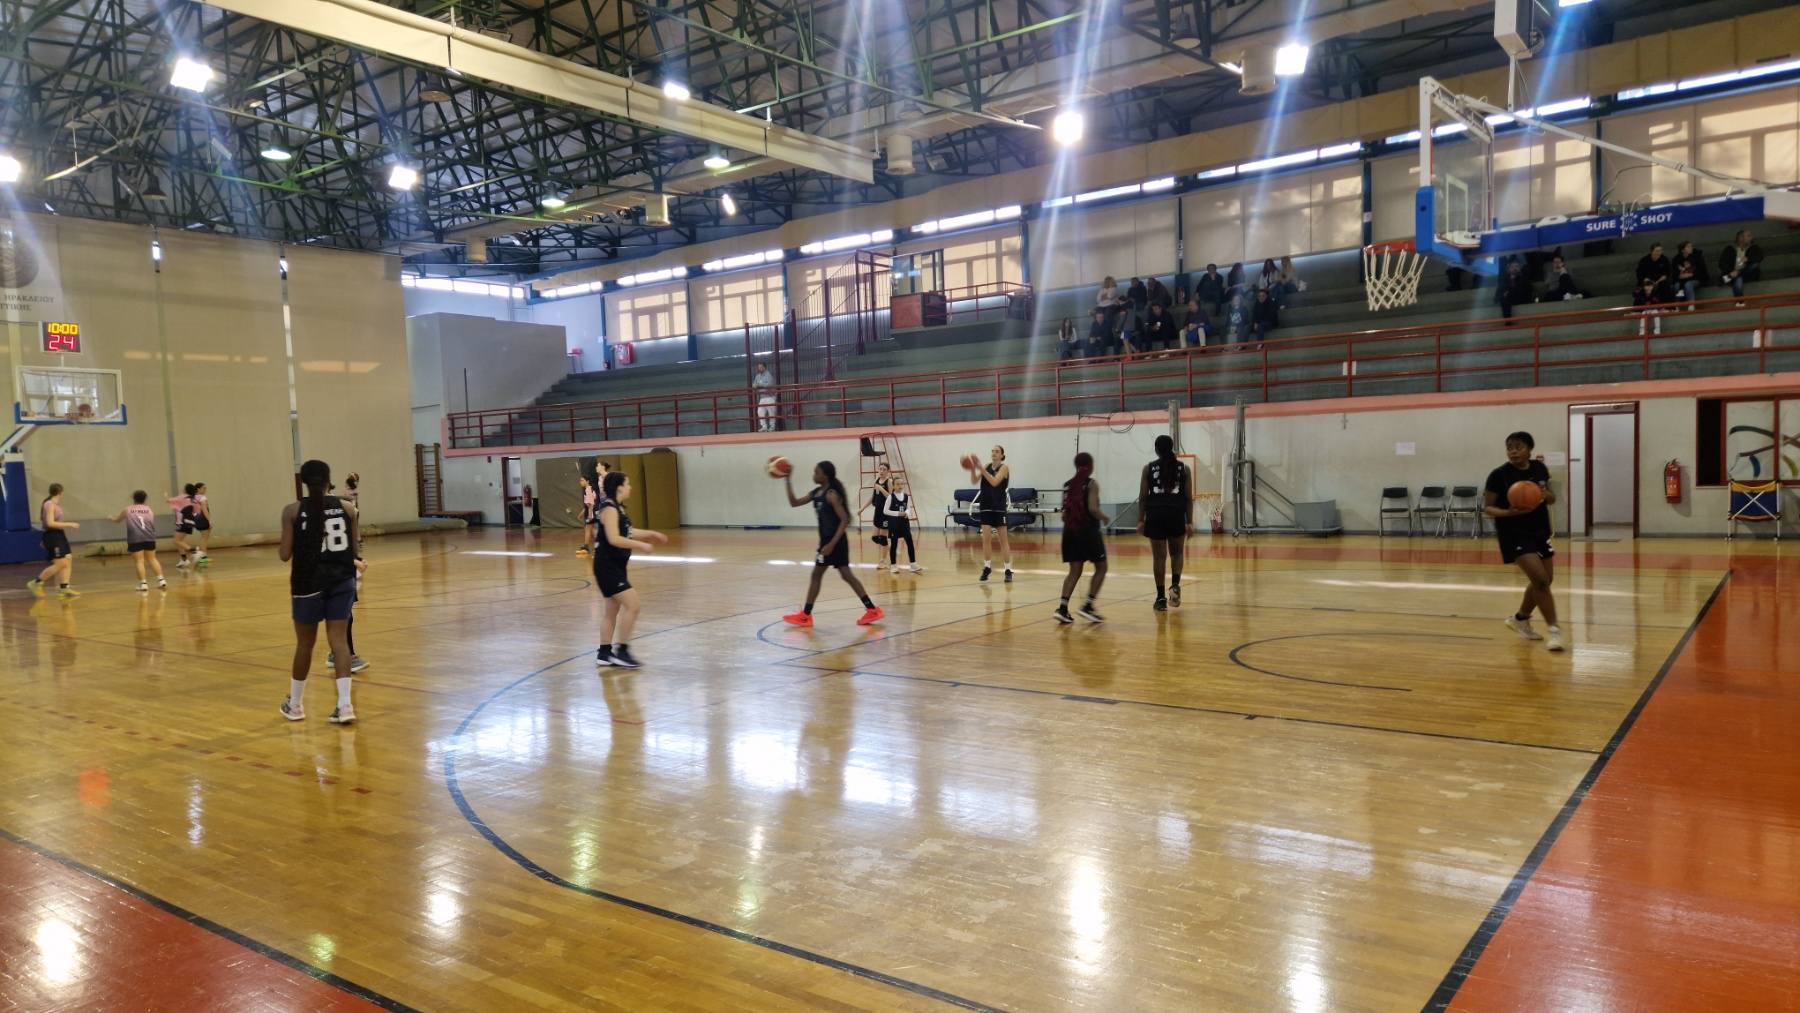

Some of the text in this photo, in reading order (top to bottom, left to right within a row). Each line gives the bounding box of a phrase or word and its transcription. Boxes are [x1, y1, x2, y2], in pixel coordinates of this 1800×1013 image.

[1586, 212, 1672, 232] SURE SHOT
[48, 323, 79, 335] 10:00
[49, 334, 74, 350] 24
